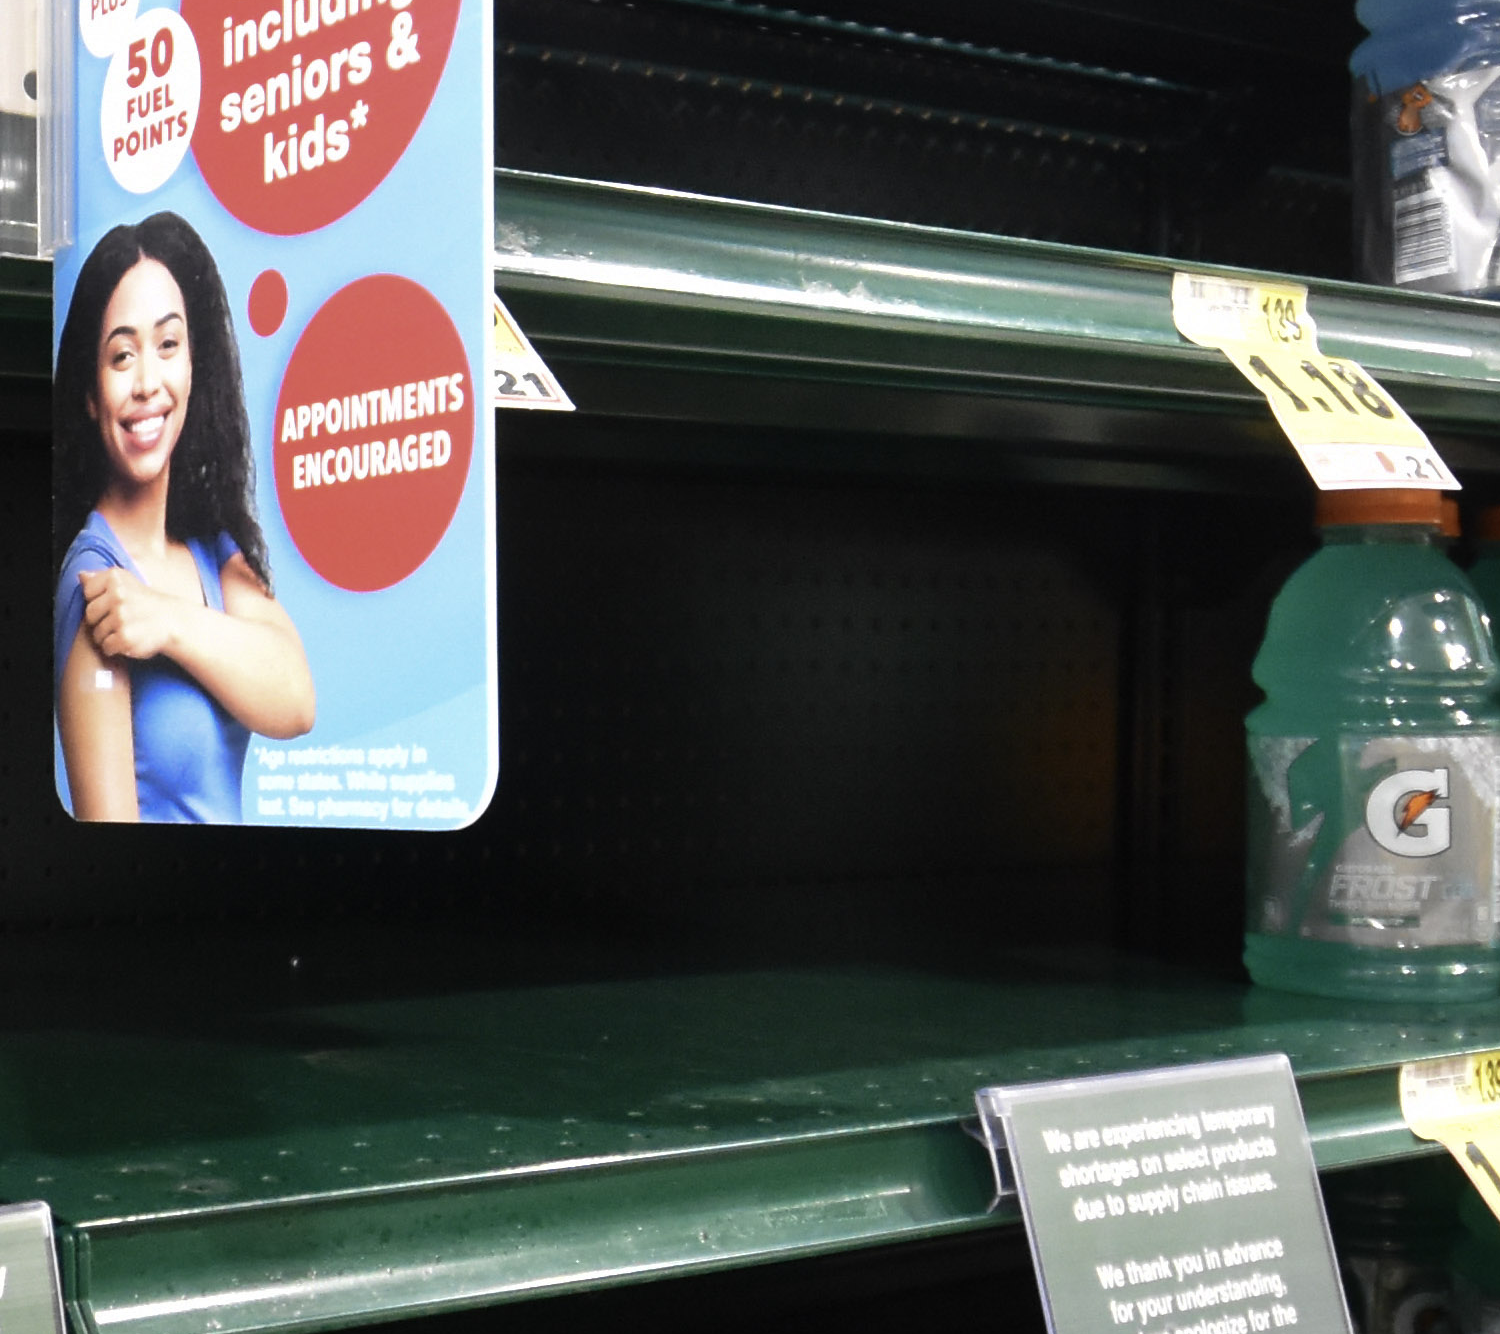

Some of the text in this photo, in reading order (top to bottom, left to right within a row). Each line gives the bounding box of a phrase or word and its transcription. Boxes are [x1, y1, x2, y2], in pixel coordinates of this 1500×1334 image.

[126, 27, 174, 87] 50
[219, 11, 421, 134] seniors &
[126, 84, 175, 123] FUEL
[113, 111, 189, 162] POINTS
[281, 373, 465, 443] APPOINTMENTS
[1250, 355, 1394, 419] 1.18
[292, 429, 451, 490] ENCOURAGED
[1366, 768, 1451, 857] G
[1042, 1106, 1275, 1154] We are experiencing temporary
[1059, 1137, 1276, 1188] shortages on select products
[1073, 1171, 1277, 1222] due to supply chain issues.
[1096, 1238, 1283, 1290] We thank you in advance
[1110, 1272, 1287, 1326] for your understanding,
[1249, 1308, 1271, 1333] for
[1273, 1304, 1298, 1327] the
